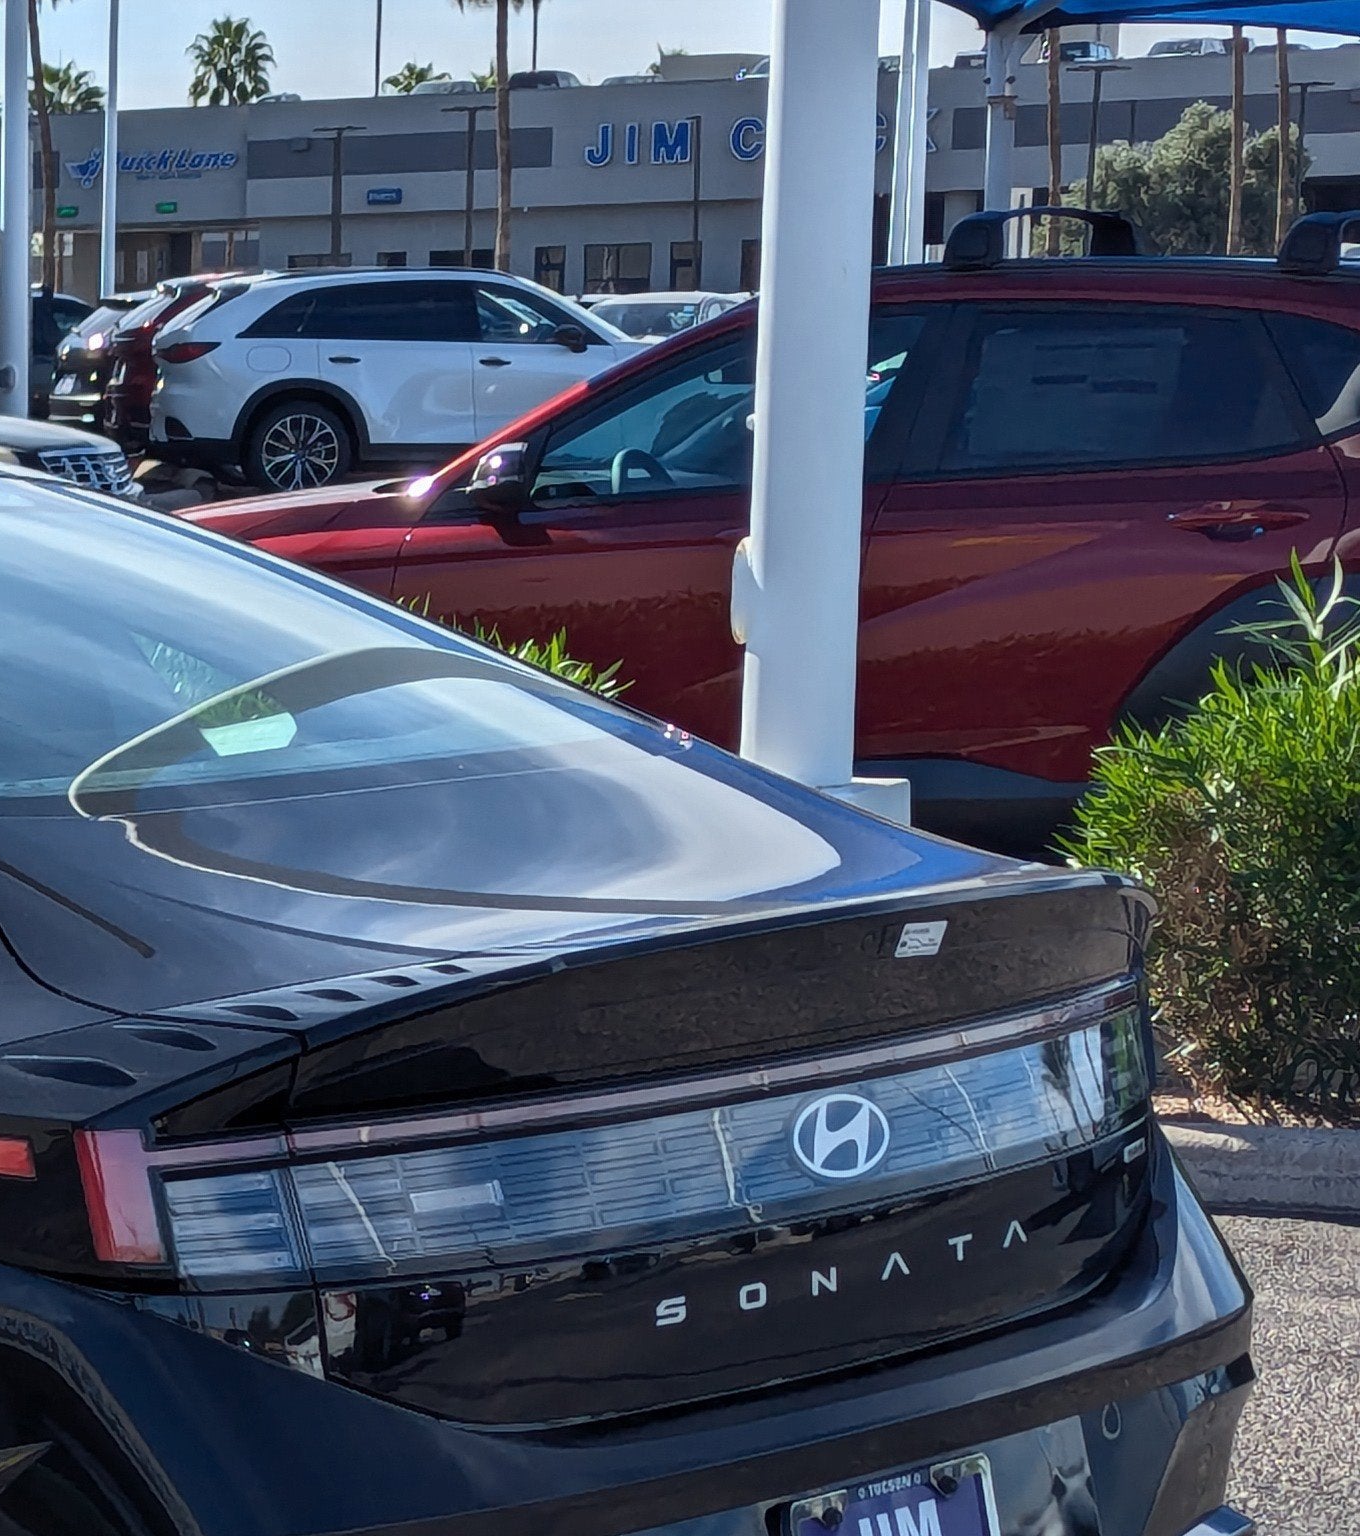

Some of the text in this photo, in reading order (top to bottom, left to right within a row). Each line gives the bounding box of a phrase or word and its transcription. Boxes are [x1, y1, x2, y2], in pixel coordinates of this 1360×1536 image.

[116, 149, 237, 172] uick Lane
[584, 120, 692, 167] JIM
[655, 1219, 1029, 1327] SONATA
